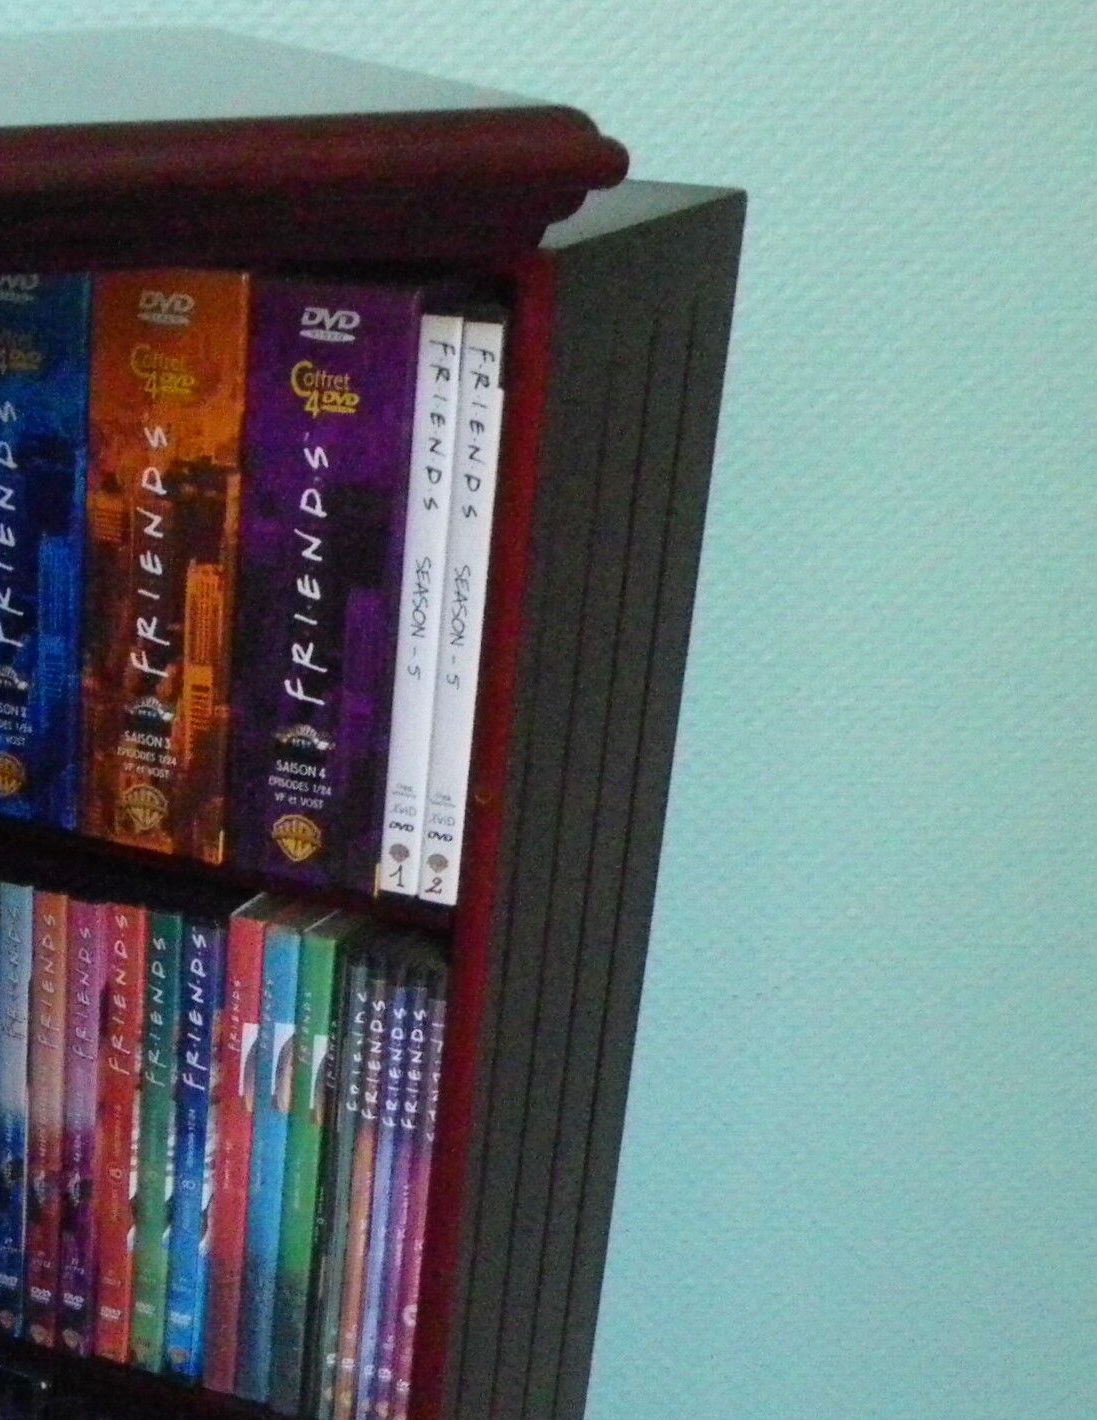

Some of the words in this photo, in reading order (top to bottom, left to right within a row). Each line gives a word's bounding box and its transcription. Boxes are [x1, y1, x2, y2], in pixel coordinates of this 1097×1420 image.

[300, 307, 360, 335] DVD
[291, 361, 351, 397] Coffret
[305, 391, 319, 417] 4
[321, 392, 359, 409] DVD
[410, 556, 432, 638] SEASON
[449, 565, 471, 646] SEASON
[407, 665, 421, 680] 5
[446, 674, 460, 690] 5
[124, 730, 162, 748] SAISON
[276, 759, 317, 778] SAISON
[300, 797, 324, 810] VOST
[389, 821, 414, 832] DVD
[428, 831, 453, 842] DVD
[389, 864, 404, 888] 1
[424, 877, 443, 894] 2
